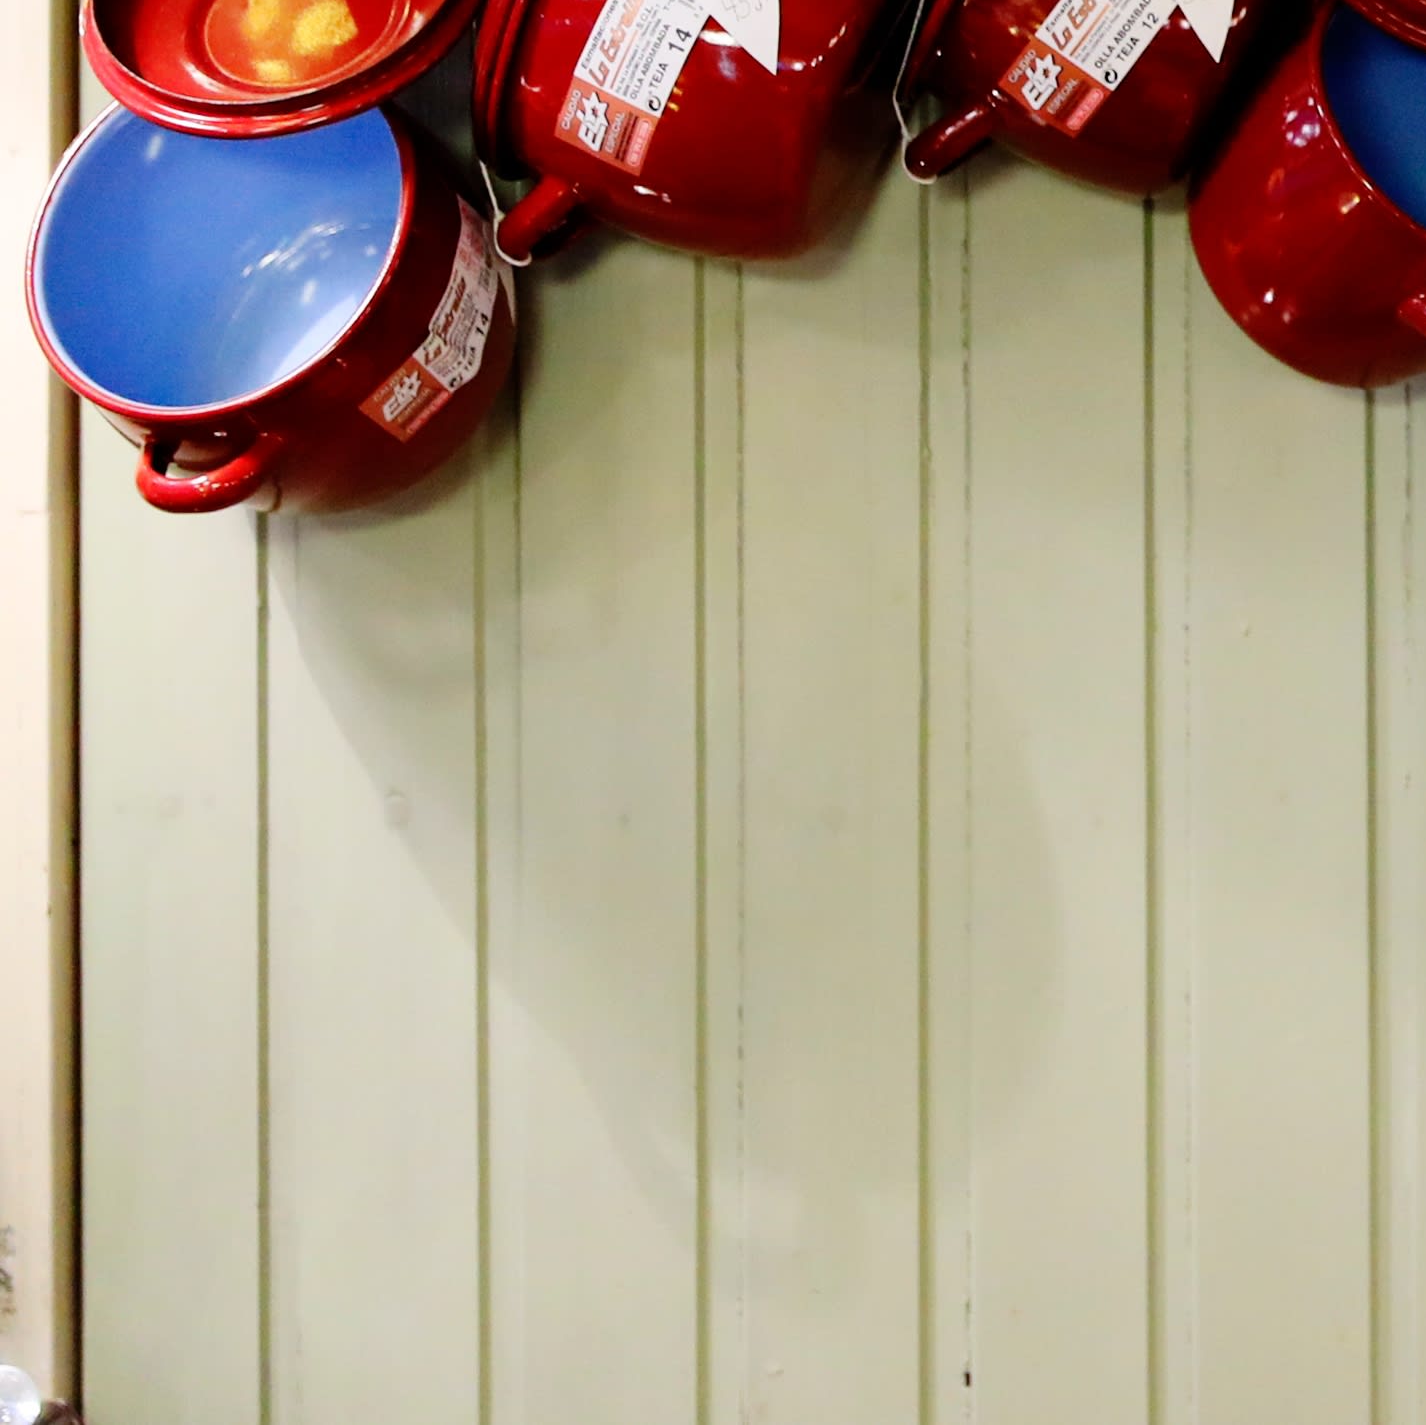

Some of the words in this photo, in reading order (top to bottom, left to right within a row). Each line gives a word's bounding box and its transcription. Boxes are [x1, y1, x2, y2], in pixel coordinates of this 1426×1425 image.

[1047, 22, 1076, 52] La
[1116, 34, 1140, 62] TEJA
[1140, 11, 1160, 32] 12
[628, 75, 644, 100] OLLA
[641, 25, 669, 73] ABOMBADA
[648, 61, 668, 89] TEJA
[665, 25, 694, 57] 14
[1094, 44, 1115, 69] OLLA
[585, 57, 612, 88] La
[475, 312, 491, 336] 14
